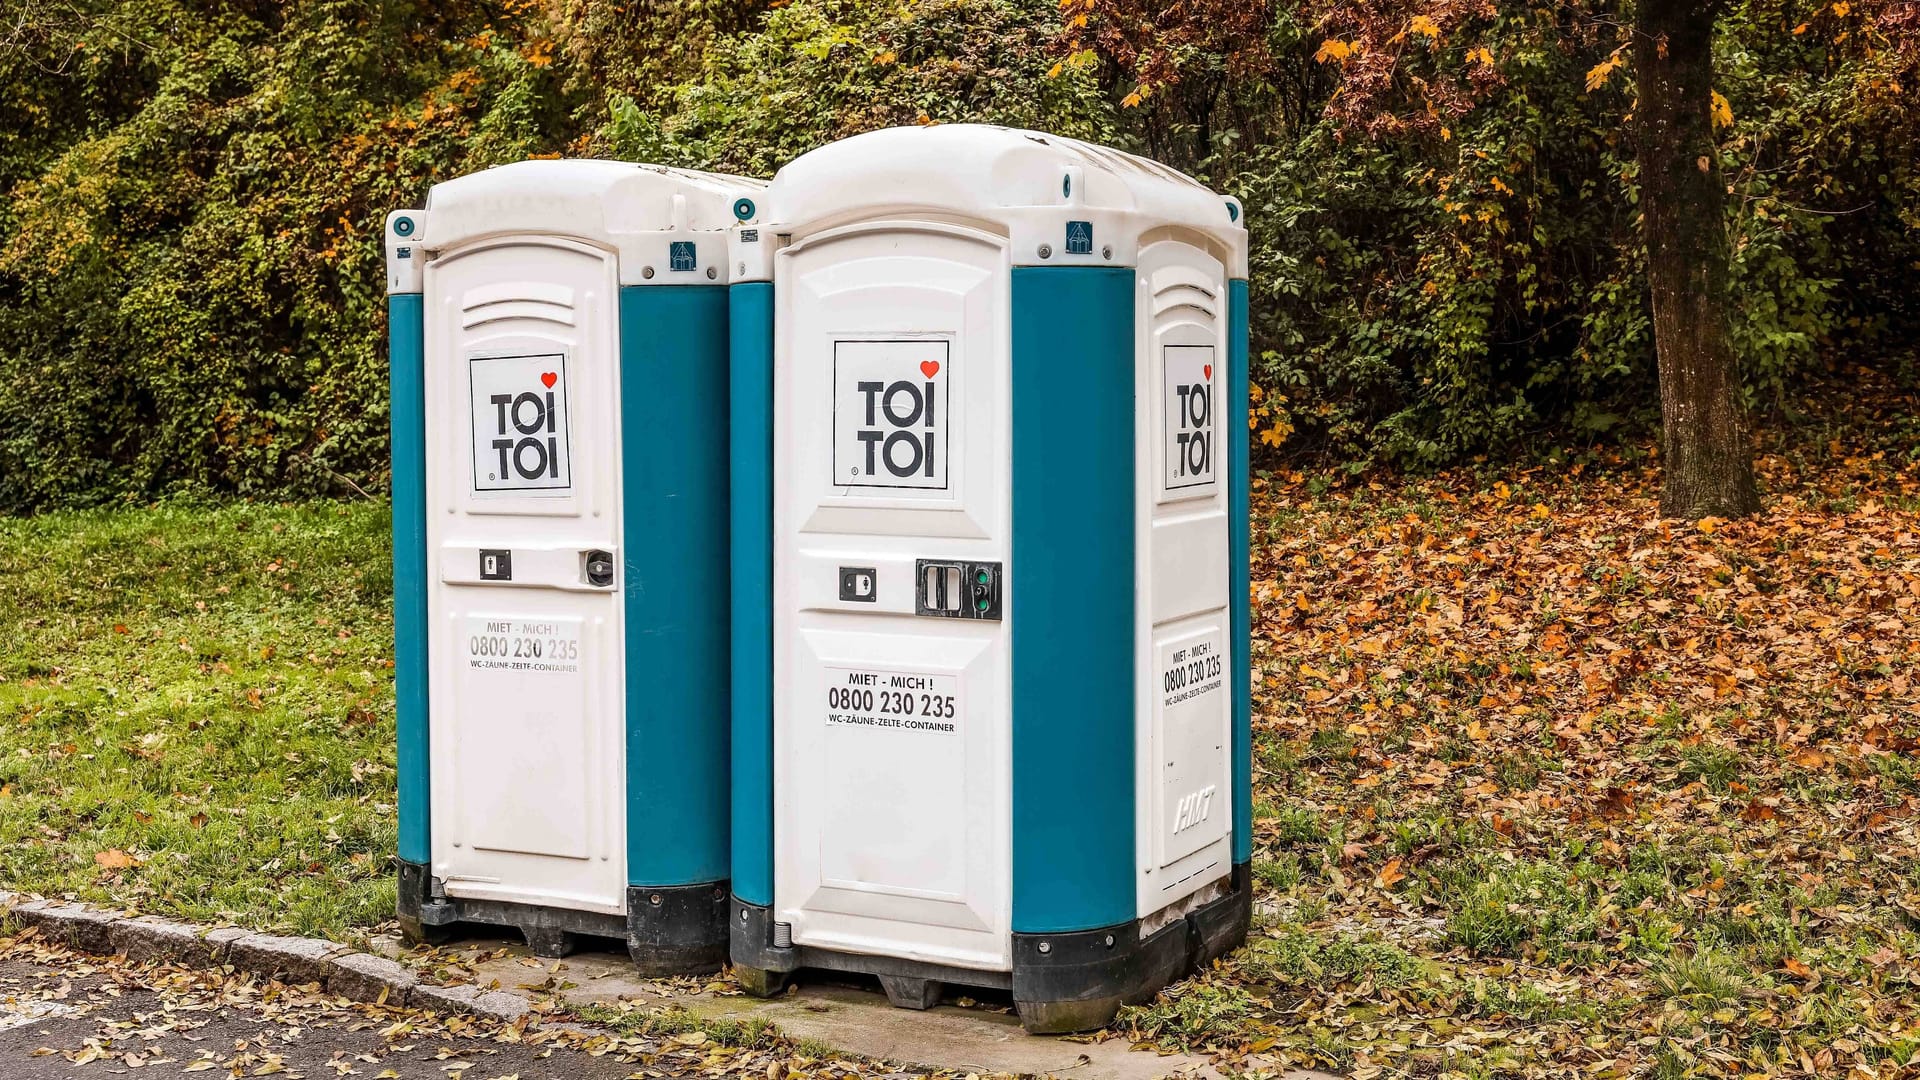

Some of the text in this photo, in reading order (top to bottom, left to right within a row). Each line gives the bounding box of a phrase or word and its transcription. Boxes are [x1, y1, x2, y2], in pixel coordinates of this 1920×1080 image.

[492, 437, 559, 480] TOI
[857, 430, 935, 477] TOI
[1177, 431, 1210, 476] TOI
[486, 622, 512, 633] MIET
[522, 624, 552, 635] MICH
[470, 635, 578, 660] 0800 230 235
[1172, 649, 1187, 664] MIET
[1191, 643, 1208, 658] MICH
[848, 673, 878, 686] MIET
[890, 676, 925, 690] MICH
[1164, 654, 1221, 693] 0800 230 235
[828, 687, 955, 718] 0800 230 235
[828, 714, 955, 732] WC-ZÄUNE-ZELTE-CONTAINER
